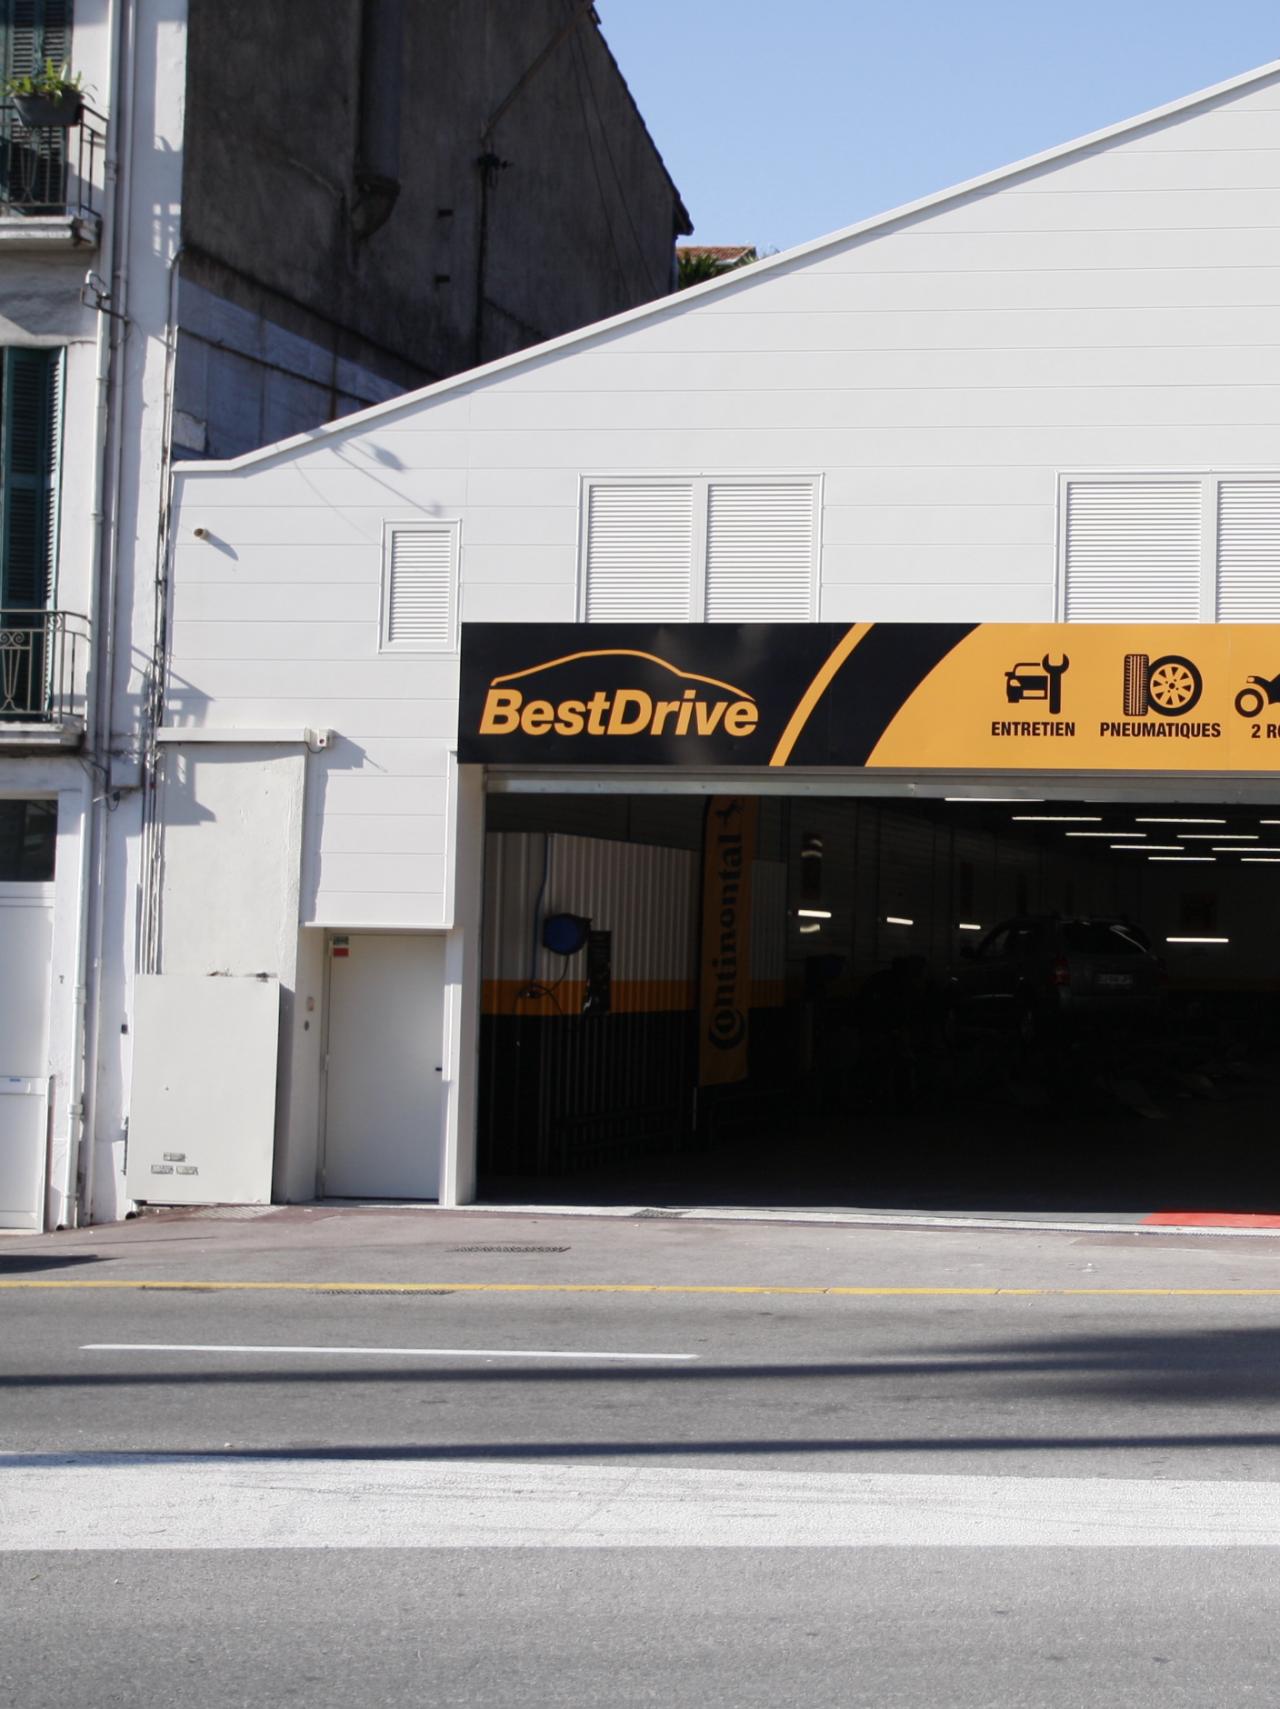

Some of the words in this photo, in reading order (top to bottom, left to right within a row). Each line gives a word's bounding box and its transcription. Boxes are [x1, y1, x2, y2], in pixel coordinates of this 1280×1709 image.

[479, 688, 759, 736] BestDrive
[991, 721, 1076, 737] ENTRETIEN
[1100, 722, 1222, 739] PNEUMATIQUES
[1250, 723, 1261, 739] 2
[708, 833, 746, 1051] Continental
